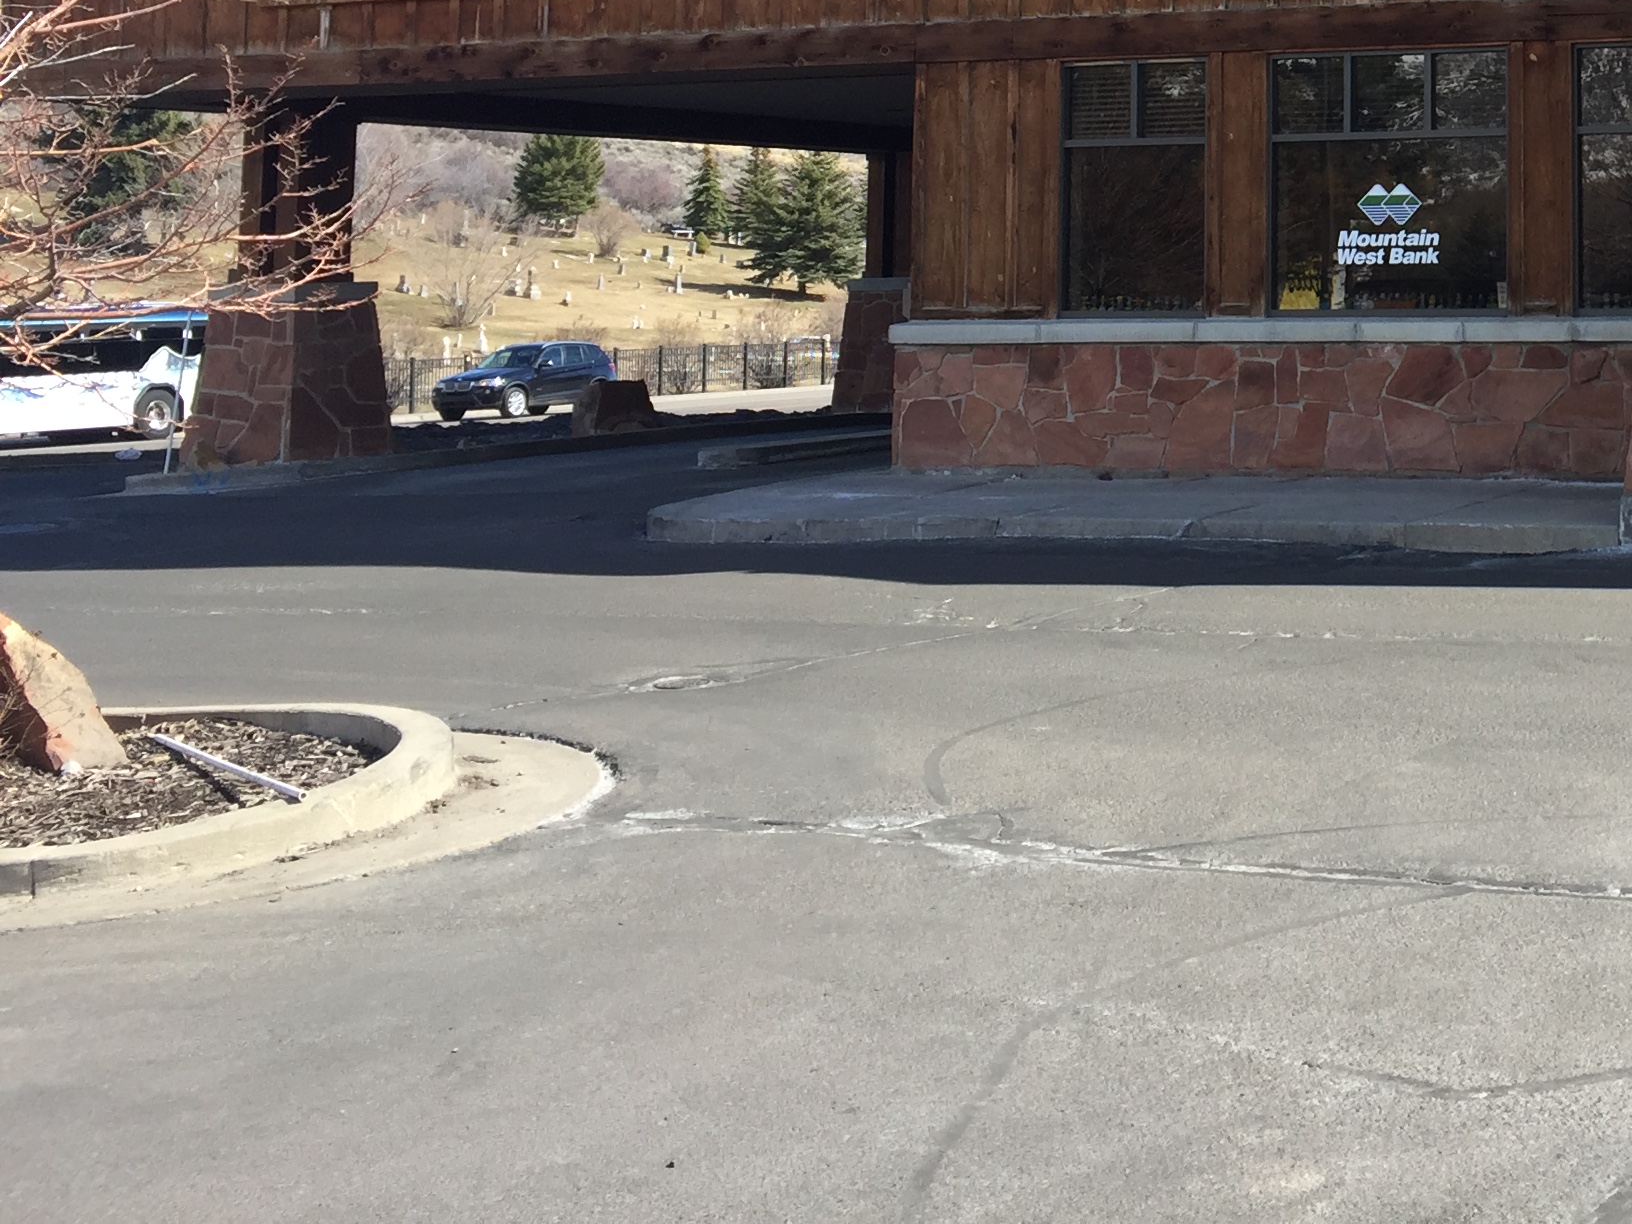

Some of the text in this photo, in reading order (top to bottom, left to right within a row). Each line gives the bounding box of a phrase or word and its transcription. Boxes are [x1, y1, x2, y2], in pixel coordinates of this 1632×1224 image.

[1337, 229, 1440, 247] Mountain
[1337, 247, 1440, 265] West Bank
